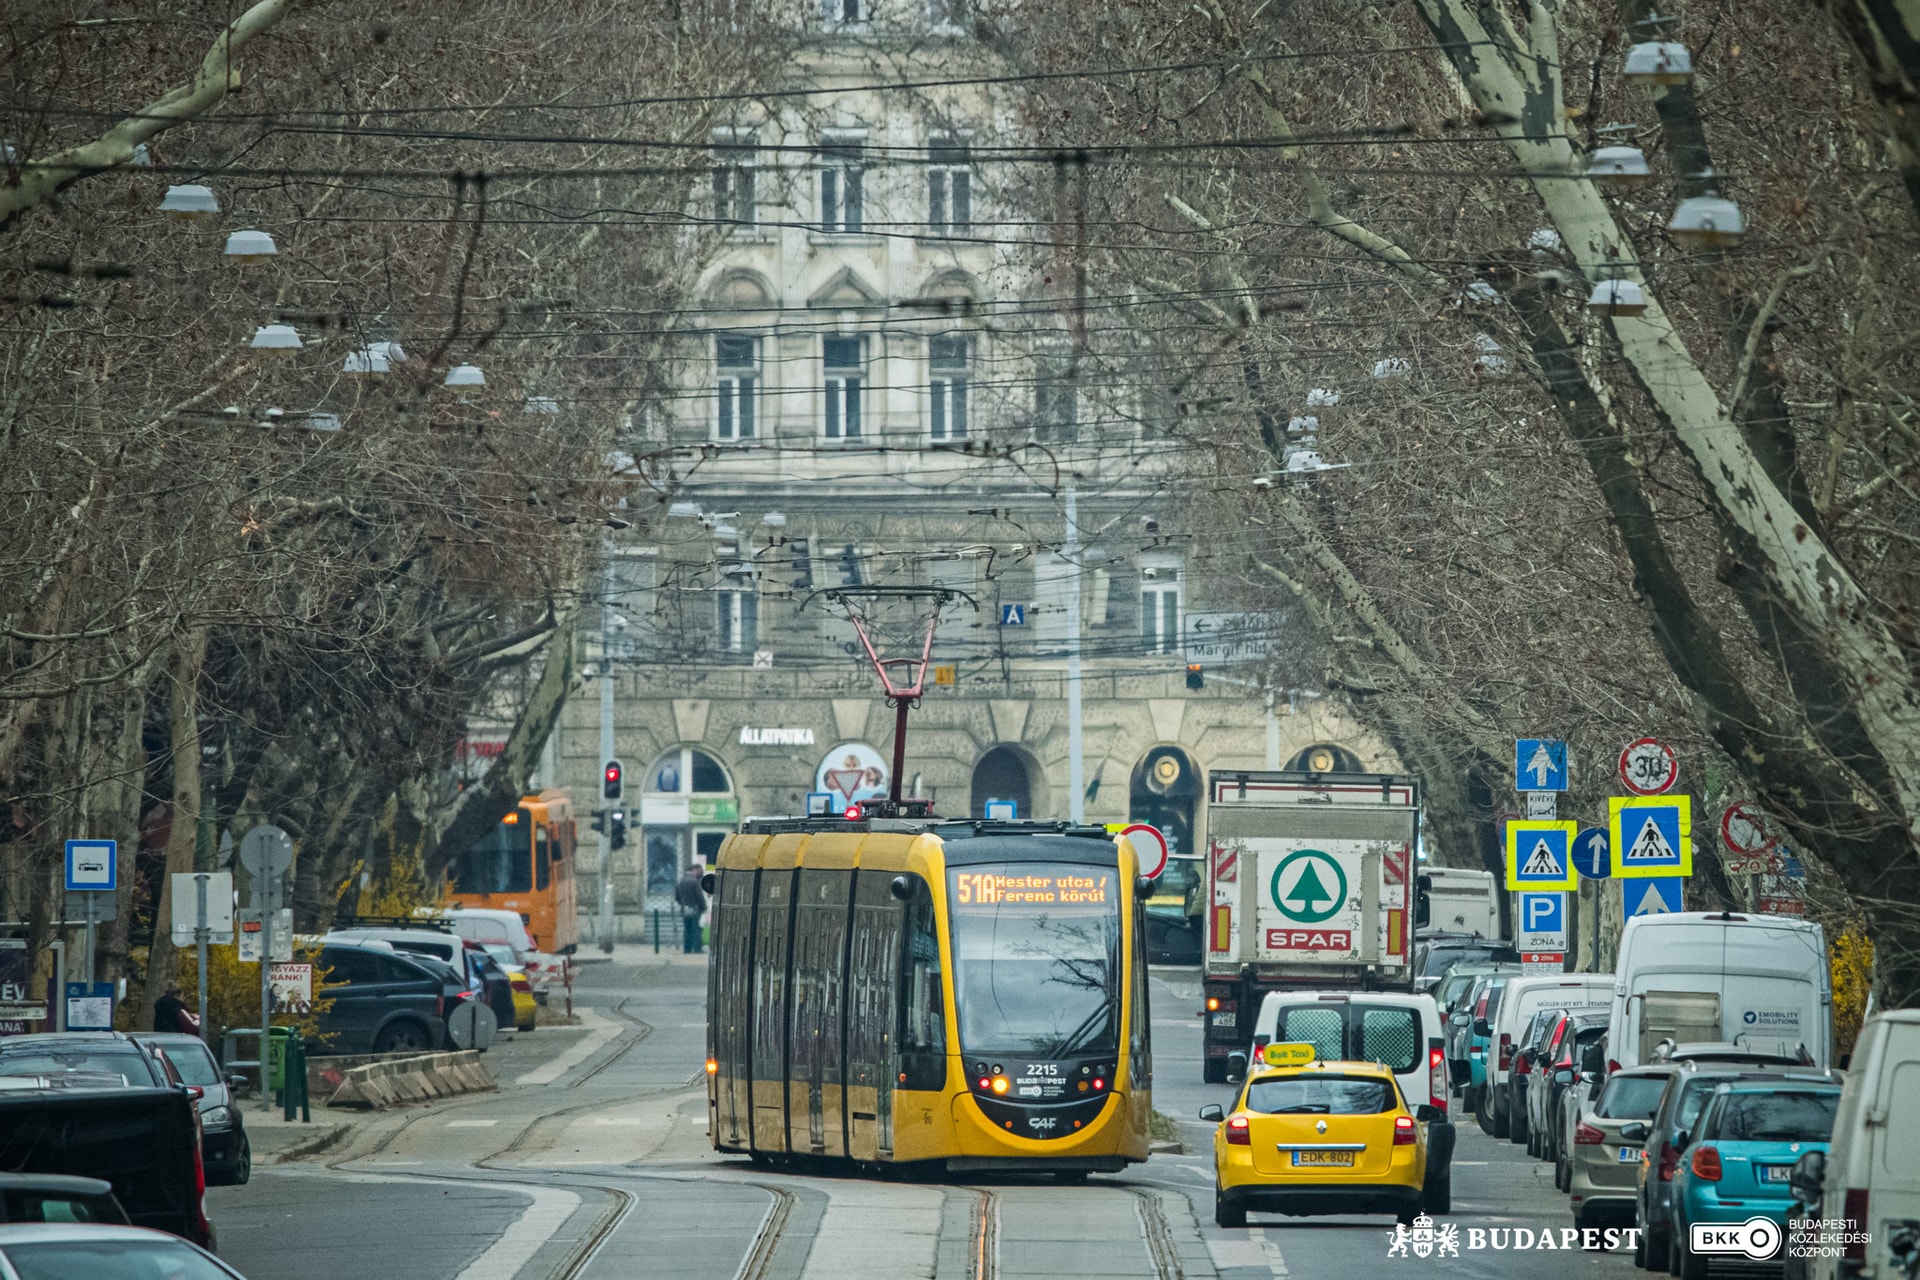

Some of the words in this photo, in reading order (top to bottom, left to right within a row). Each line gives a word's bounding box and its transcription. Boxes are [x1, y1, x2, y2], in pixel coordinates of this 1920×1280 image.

[1635, 756, 1662, 778] 30
[1529, 794, 1555, 803] KIVÉVE
[996, 875, 1052, 888] Mester
[1057, 876, 1094, 888] utca
[958, 874, 996, 904] 51A
[996, 890, 1055, 903] Ferenc
[1530, 898, 1555, 929] P
[1270, 932, 1348, 948] SPAR
[271, 964, 310, 973] IGYÁZZ
[1758, 1017, 1799, 1025] SOLUTIONS
[1291, 1049, 1309, 1058] Taxi
[1027, 1064, 1058, 1076] 2215
[1028, 1117, 1057, 1129] CAF
[1301, 1151, 1351, 1163] EDK-802
[1771, 1167, 1789, 1180] LK
